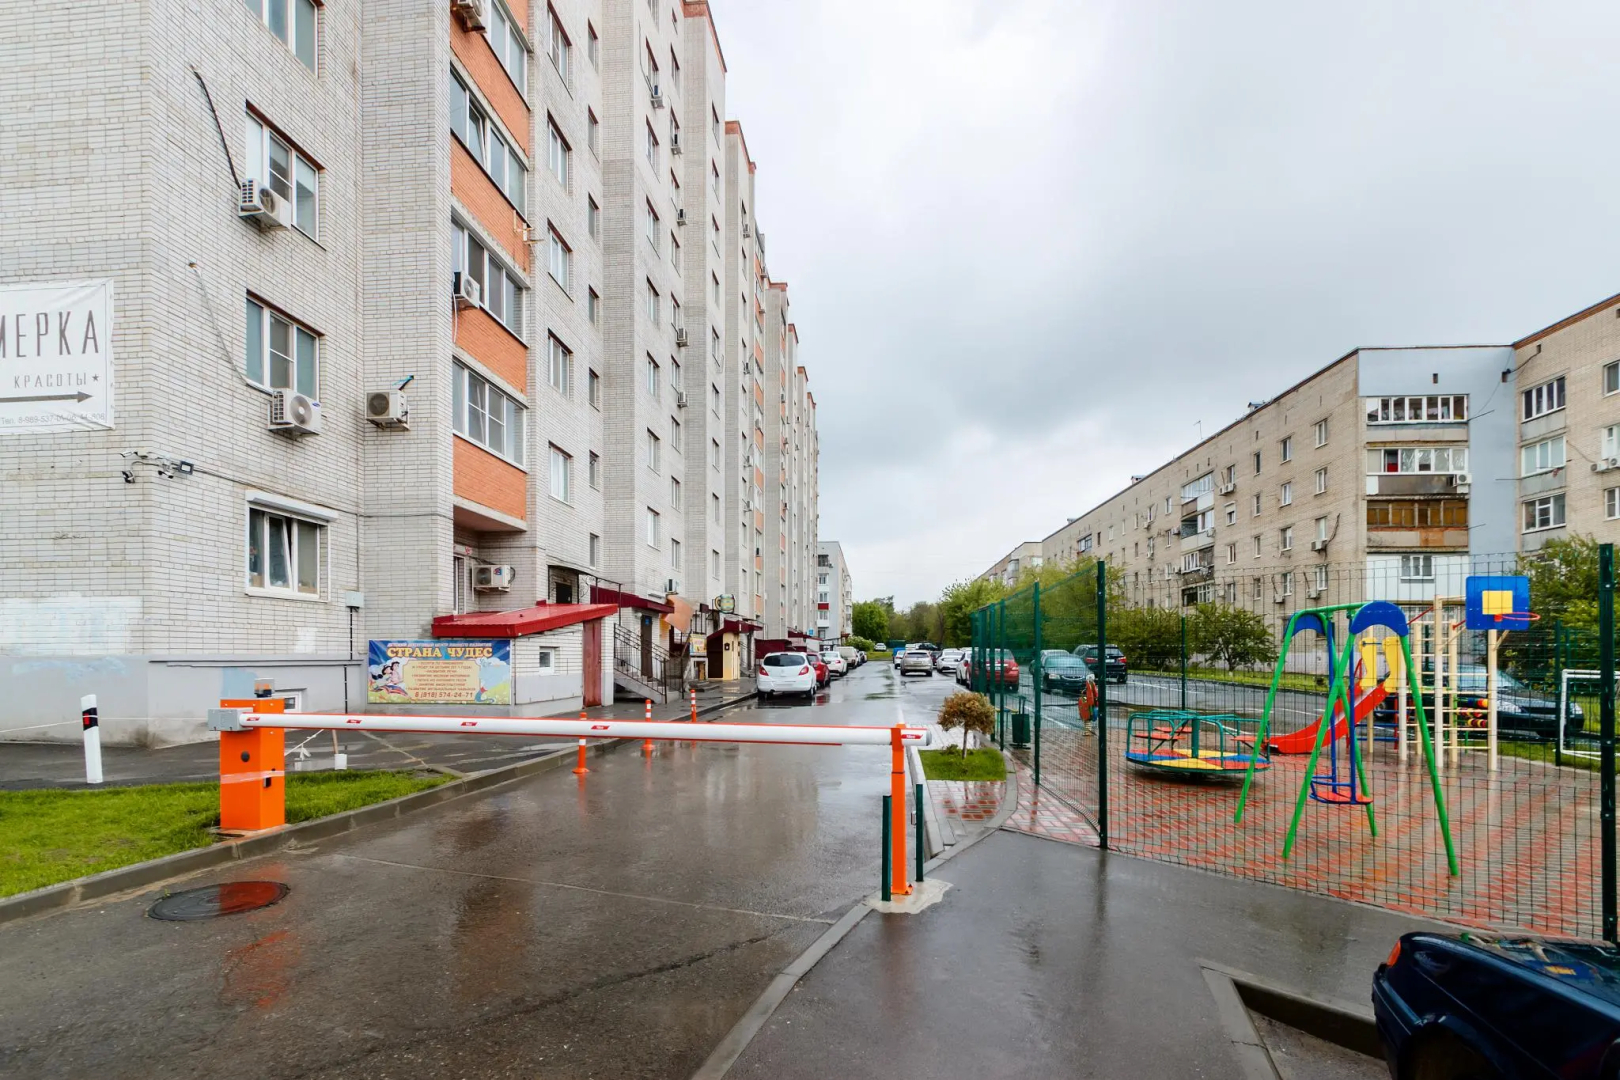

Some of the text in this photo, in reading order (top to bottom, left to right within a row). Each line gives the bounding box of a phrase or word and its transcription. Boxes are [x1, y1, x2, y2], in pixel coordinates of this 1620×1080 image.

[14, 373, 87, 388] КРАСОТЫ
[387, 648, 493, 658] СТРАНА ЧУДЕС
